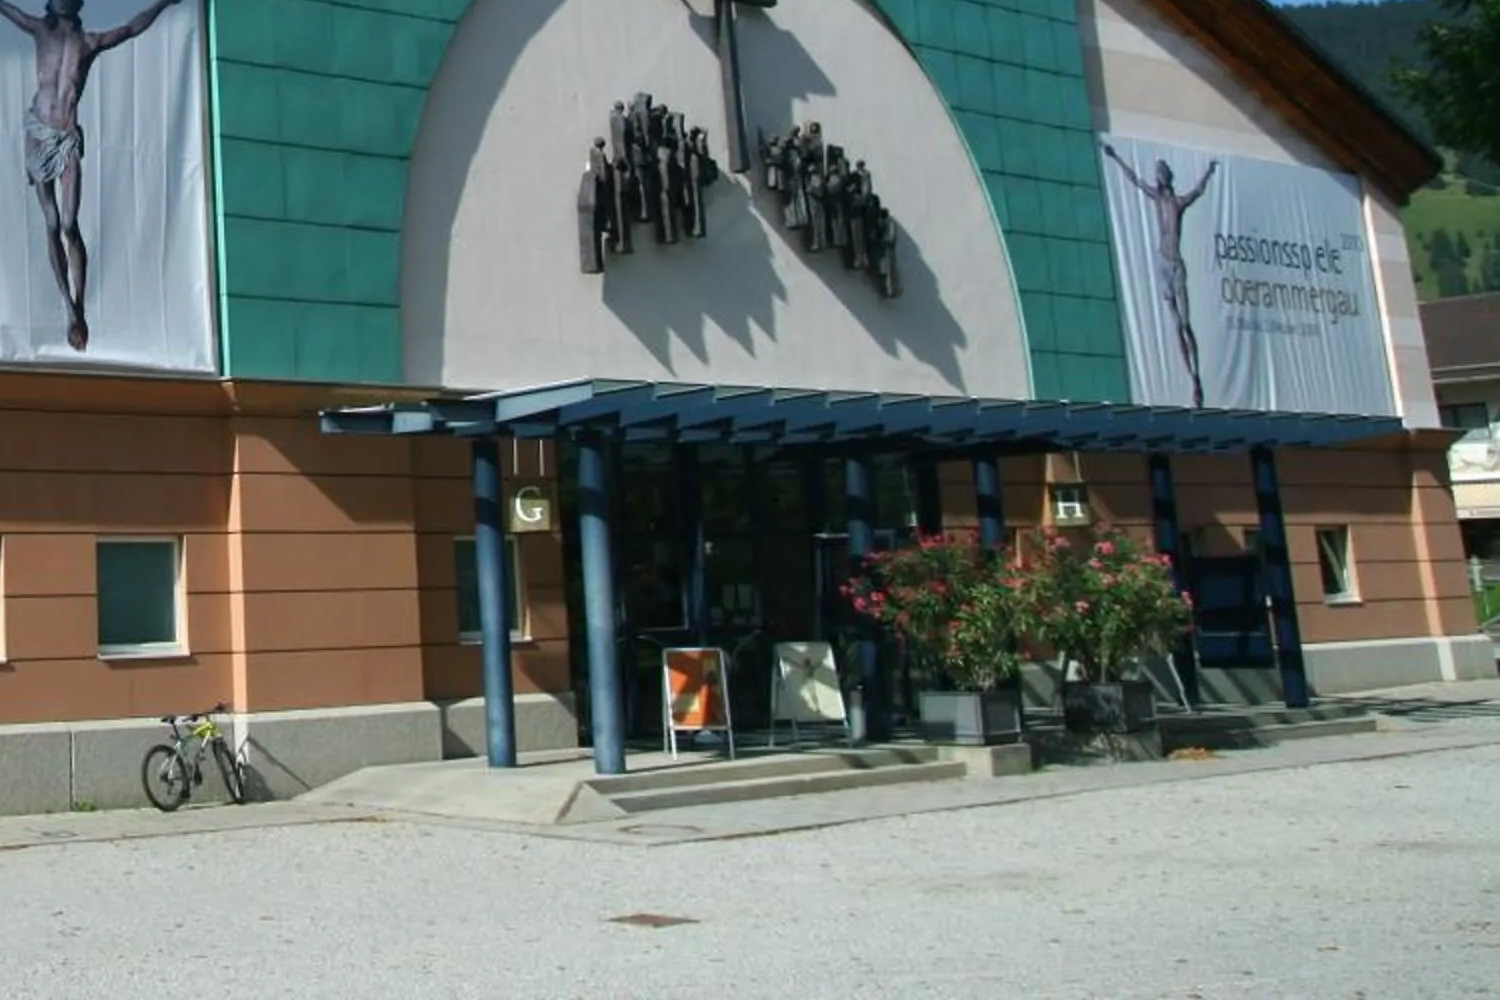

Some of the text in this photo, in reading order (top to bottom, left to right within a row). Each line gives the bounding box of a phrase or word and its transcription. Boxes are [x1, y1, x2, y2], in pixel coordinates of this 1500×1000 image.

[1214, 229, 1343, 278] passionsspele
[514, 485, 544, 522] G
[1055, 489, 1085, 519] H
